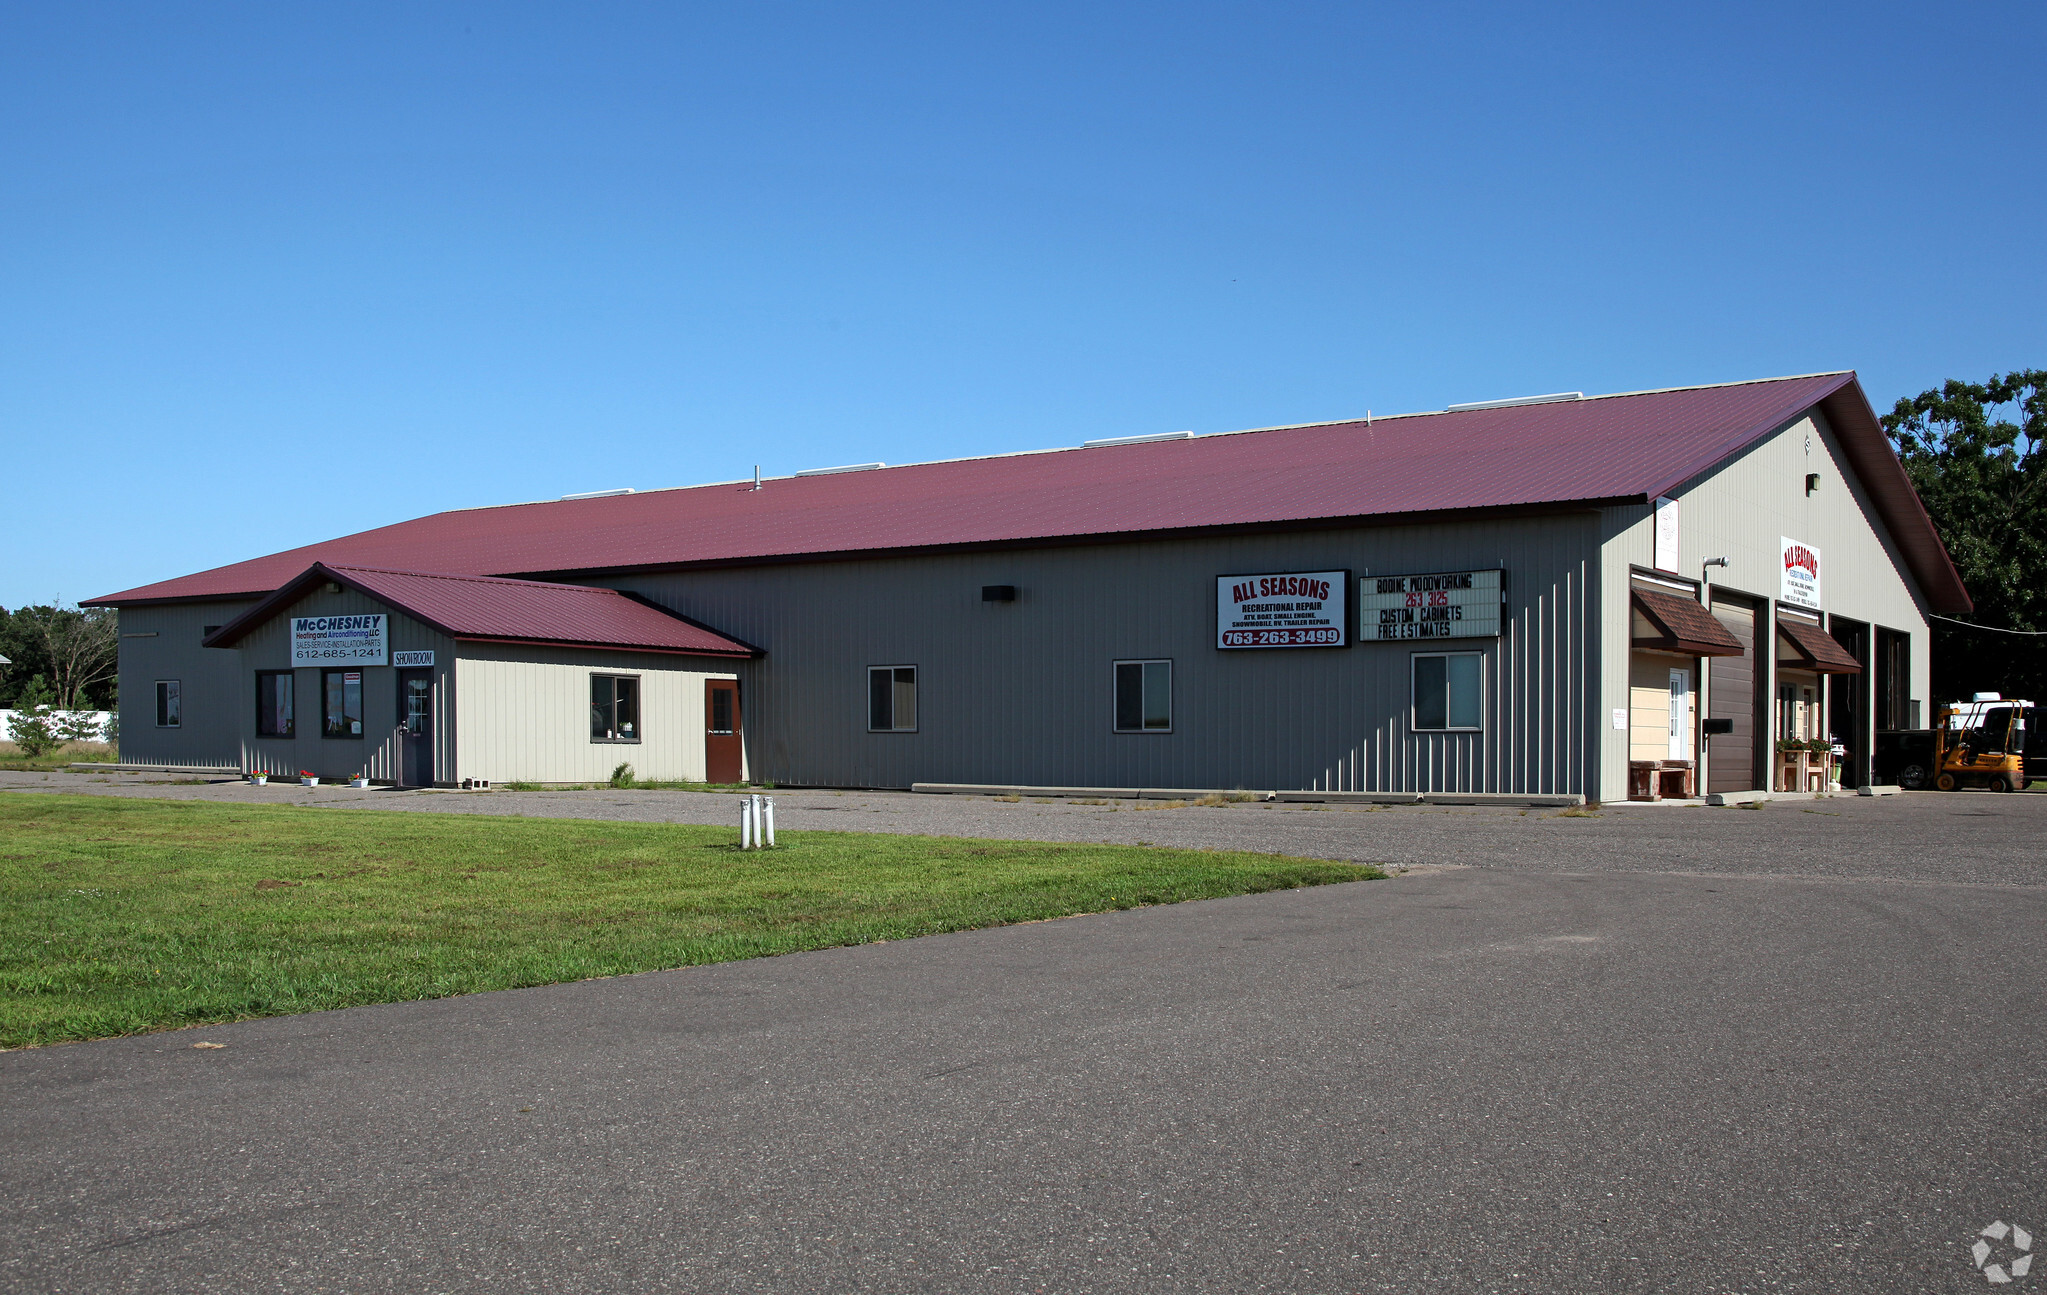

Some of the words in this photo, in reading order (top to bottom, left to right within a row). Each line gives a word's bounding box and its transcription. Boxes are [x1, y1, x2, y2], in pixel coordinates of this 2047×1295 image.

[1784, 547, 1794, 572] ALL
[1795, 546, 1818, 579] SEASONS
[1233, 581, 1257, 603] ALL
[1260, 577, 1330, 601] SEASONS
[1410, 574, 1472, 591] WOODWORKING
[1405, 592, 1423, 607] 263
[1427, 590, 1448, 607] 3125
[1242, 603, 1294, 613] RECREATIONAL
[1296, 602, 1322, 611] REPAIR
[1380, 608, 1414, 624] CUSTOM
[1420, 606, 1461, 622] CABINETS
[296, 616, 381, 631] McCHESNEY
[1378, 623, 1398, 639] FREE
[1400, 621, 1451, 638] ESTIMATES
[296, 632, 316, 640] Heating
[327, 630, 368, 639] Airconditioning
[1225, 630, 1337, 644] 763-263-3499
[296, 648, 381, 658] 612-685-1241
[396, 652, 432, 664] SHOWROOM
